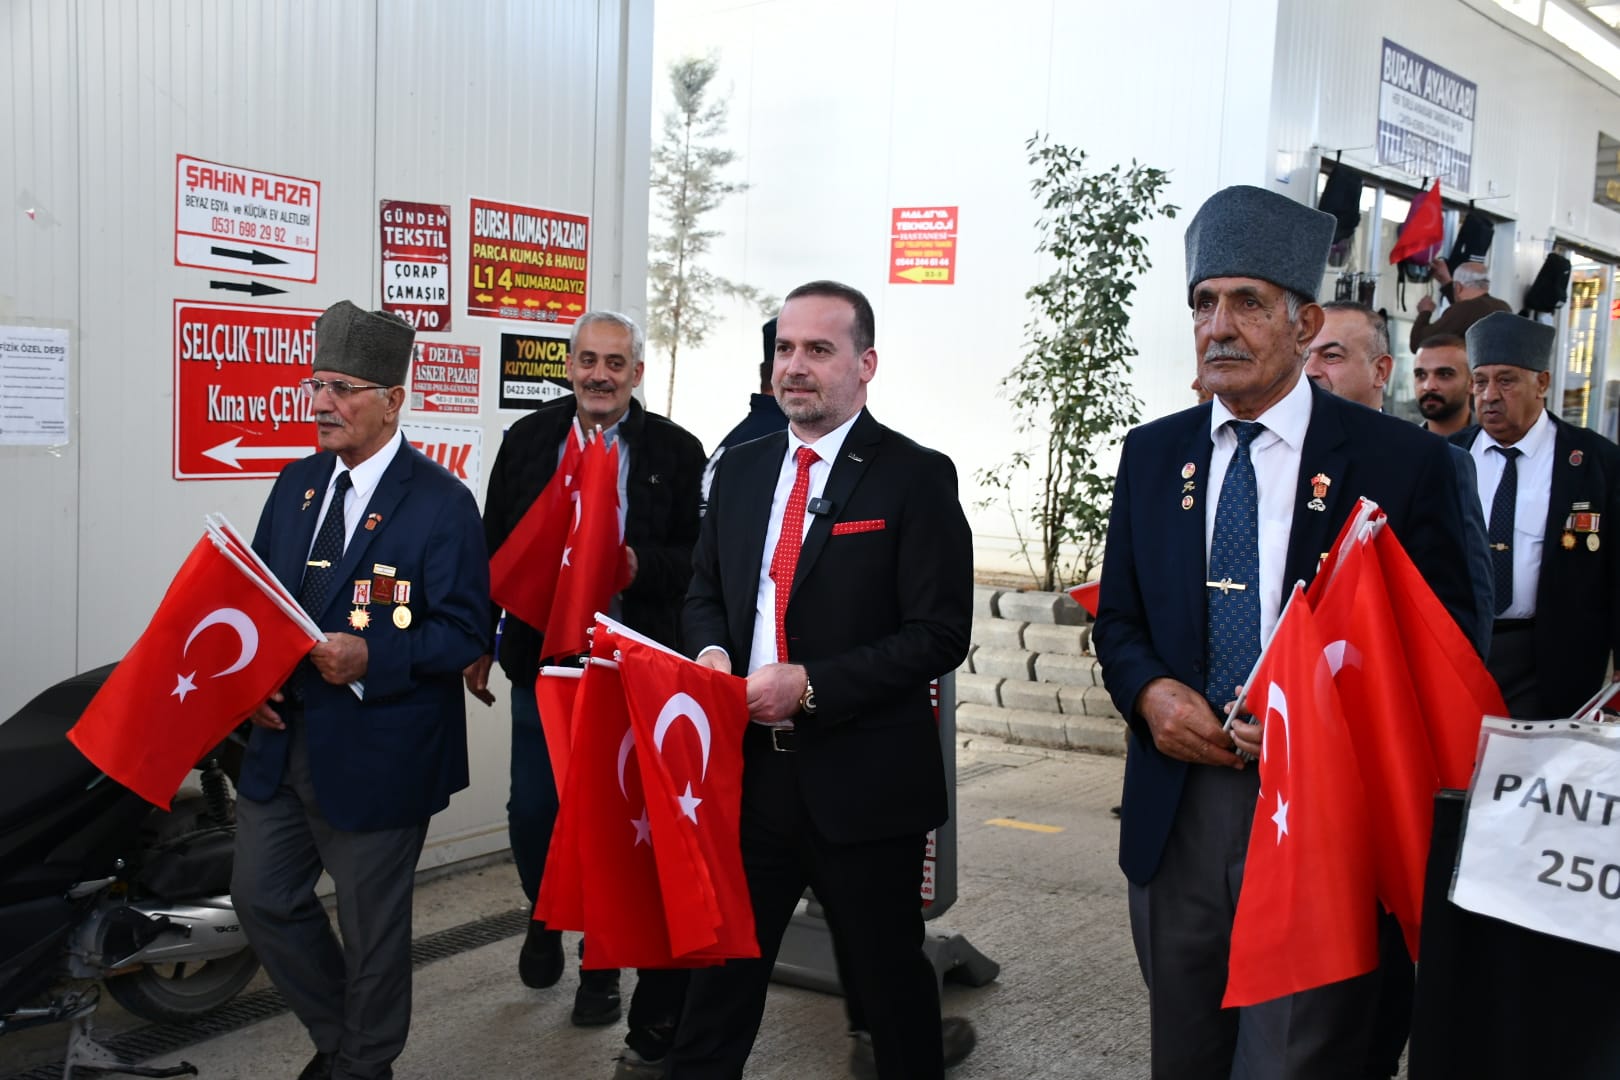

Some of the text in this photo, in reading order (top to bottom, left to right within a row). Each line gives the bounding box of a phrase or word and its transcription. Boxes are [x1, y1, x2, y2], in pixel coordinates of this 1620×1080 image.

[1383, 47, 1424, 95] BURAK
[1422, 68, 1475, 119] AYAKKABI
[252, 177, 311, 207] PLAZA
[185, 194, 209, 210] BEYAZ
[210, 198, 229, 213] EŞYA
[233, 205, 242, 215] ve
[243, 203, 268, 220] KÜÇÜK
[269, 209, 279, 221] EV
[384, 208, 447, 227] GÜNDEM
[211, 216, 286, 243] 0531 698 29 92
[474, 207, 586, 251] BURSA KUMAŞ PAZARI
[473, 243, 586, 271] PARÇA KUMAŞ & HAVLU
[395, 263, 438, 279] ÇORAP
[514, 273, 585, 295] NUMARADAYIZ
[387, 285, 446, 302] ÇAMAŞIR
[182, 322, 252, 370] SELÇUK
[428, 347, 465, 364] DELTA
[516, 339, 567, 363] YONCA
[416, 364, 479, 385] ASKER PAZARI
[208, 384, 245, 422] Kına
[248, 395, 267, 422] ve
[506, 384, 525, 395] 0422
[526, 386, 540, 395] 504
[541, 387, 551, 396] 41
[1493, 773, 1620, 826] PANT
[1537, 849, 1620, 900] 250
